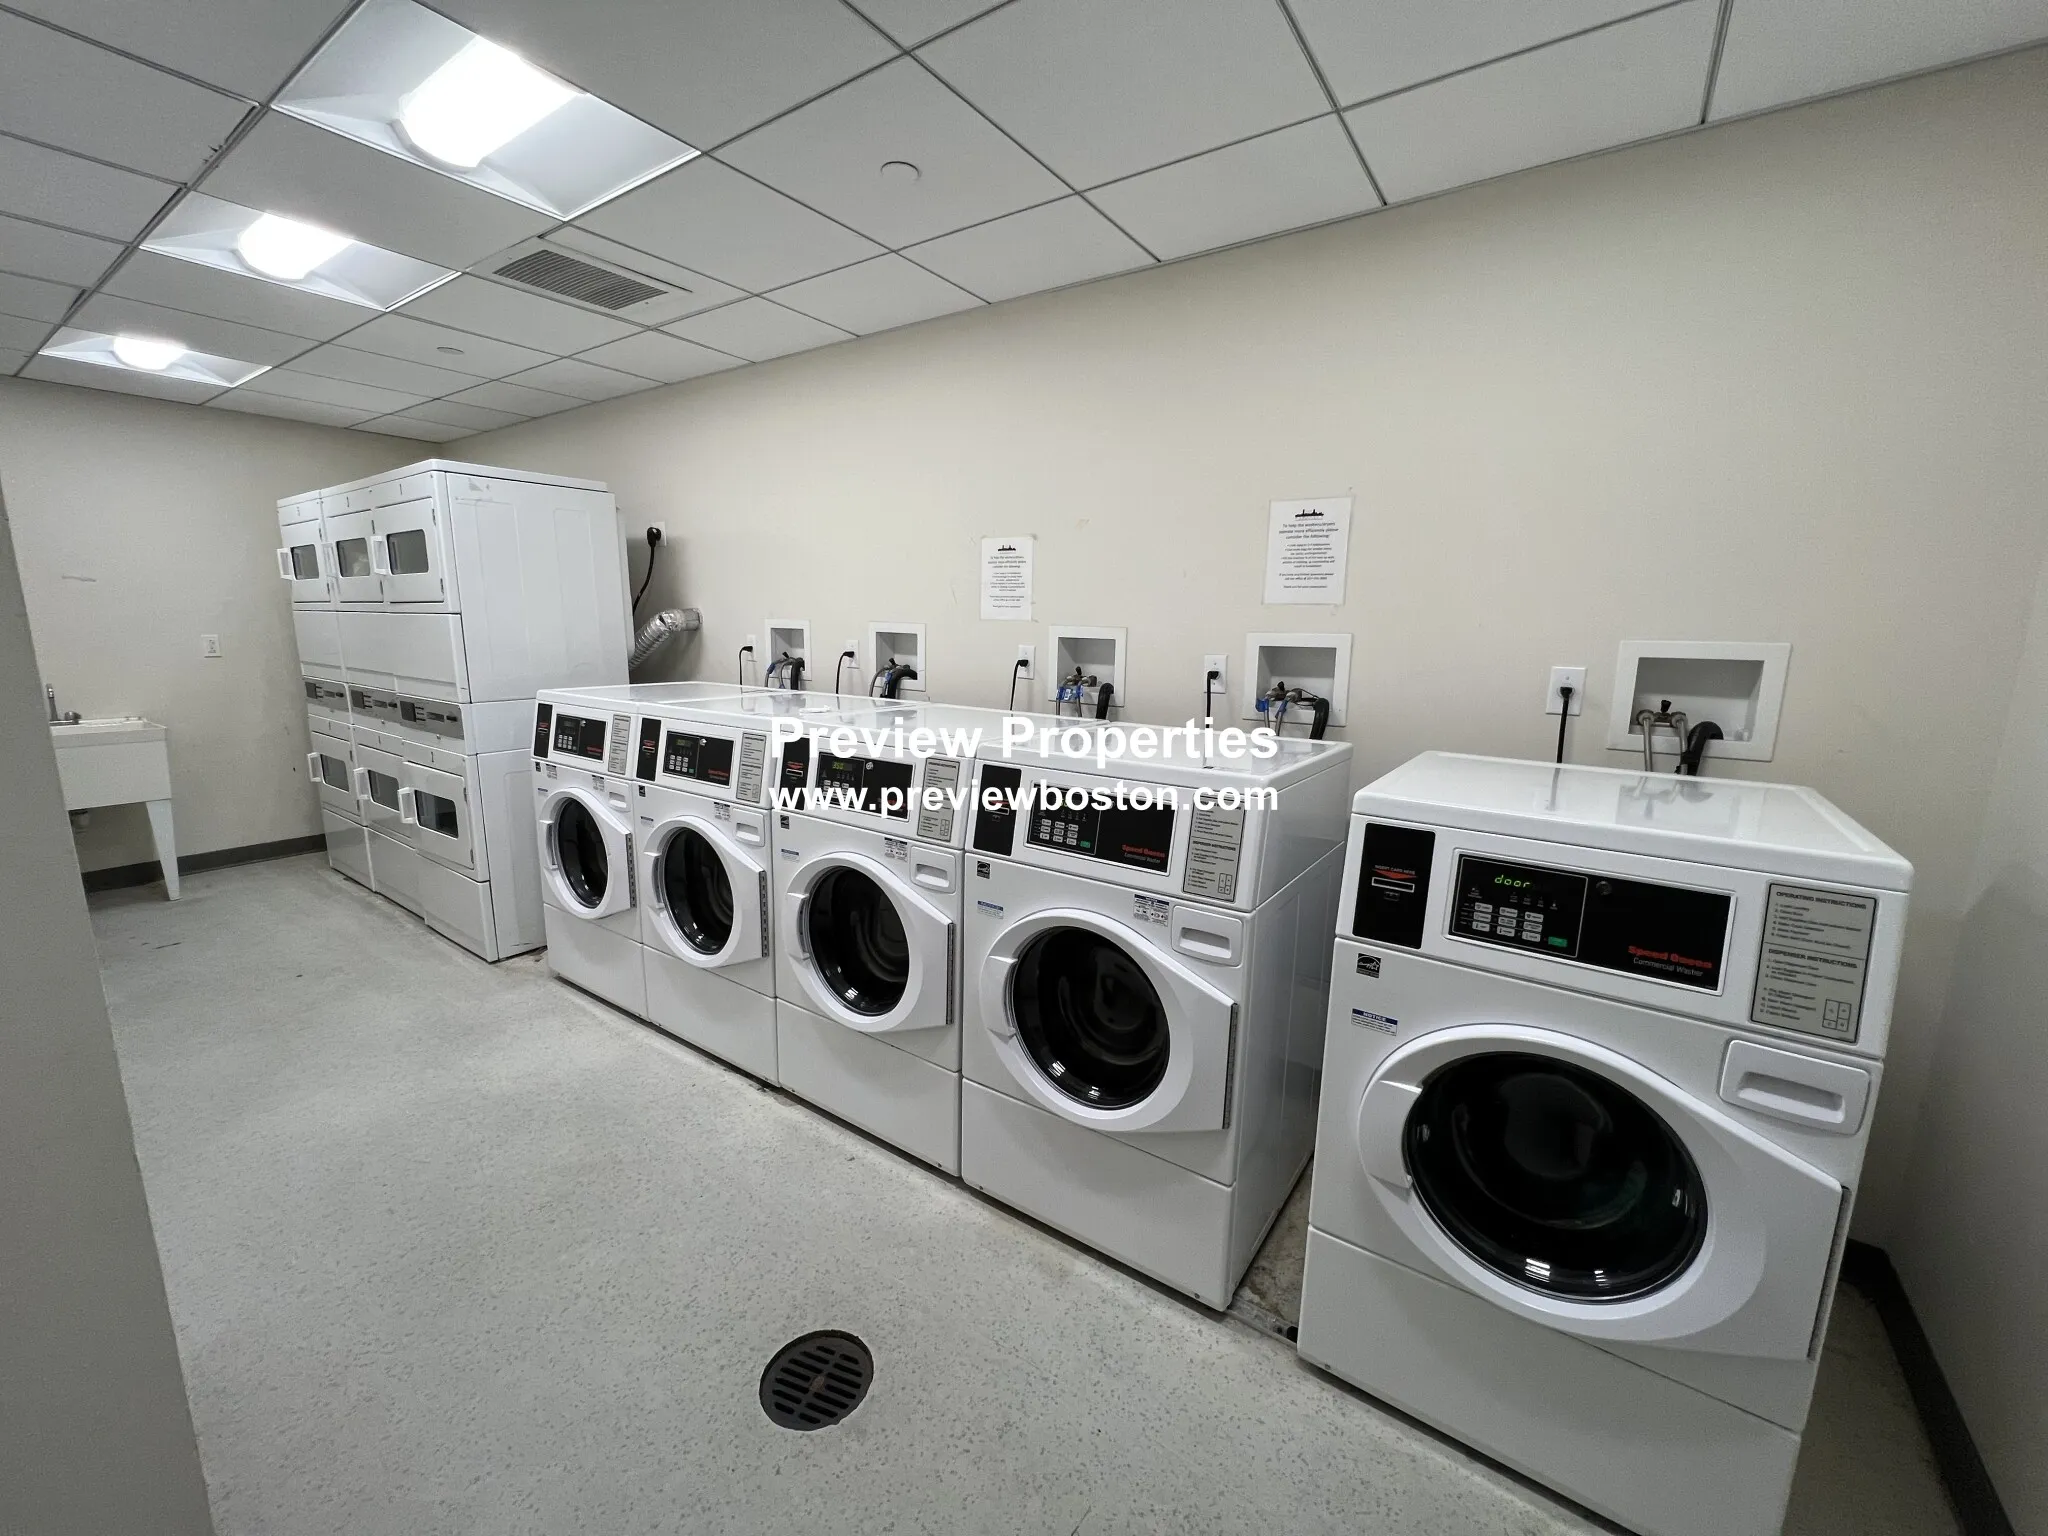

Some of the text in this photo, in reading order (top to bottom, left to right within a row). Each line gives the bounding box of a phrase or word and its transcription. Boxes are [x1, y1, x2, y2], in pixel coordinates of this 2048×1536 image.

[1494, 874, 1531, 888] door
[1633, 957, 1704, 977] Commercial Washer
